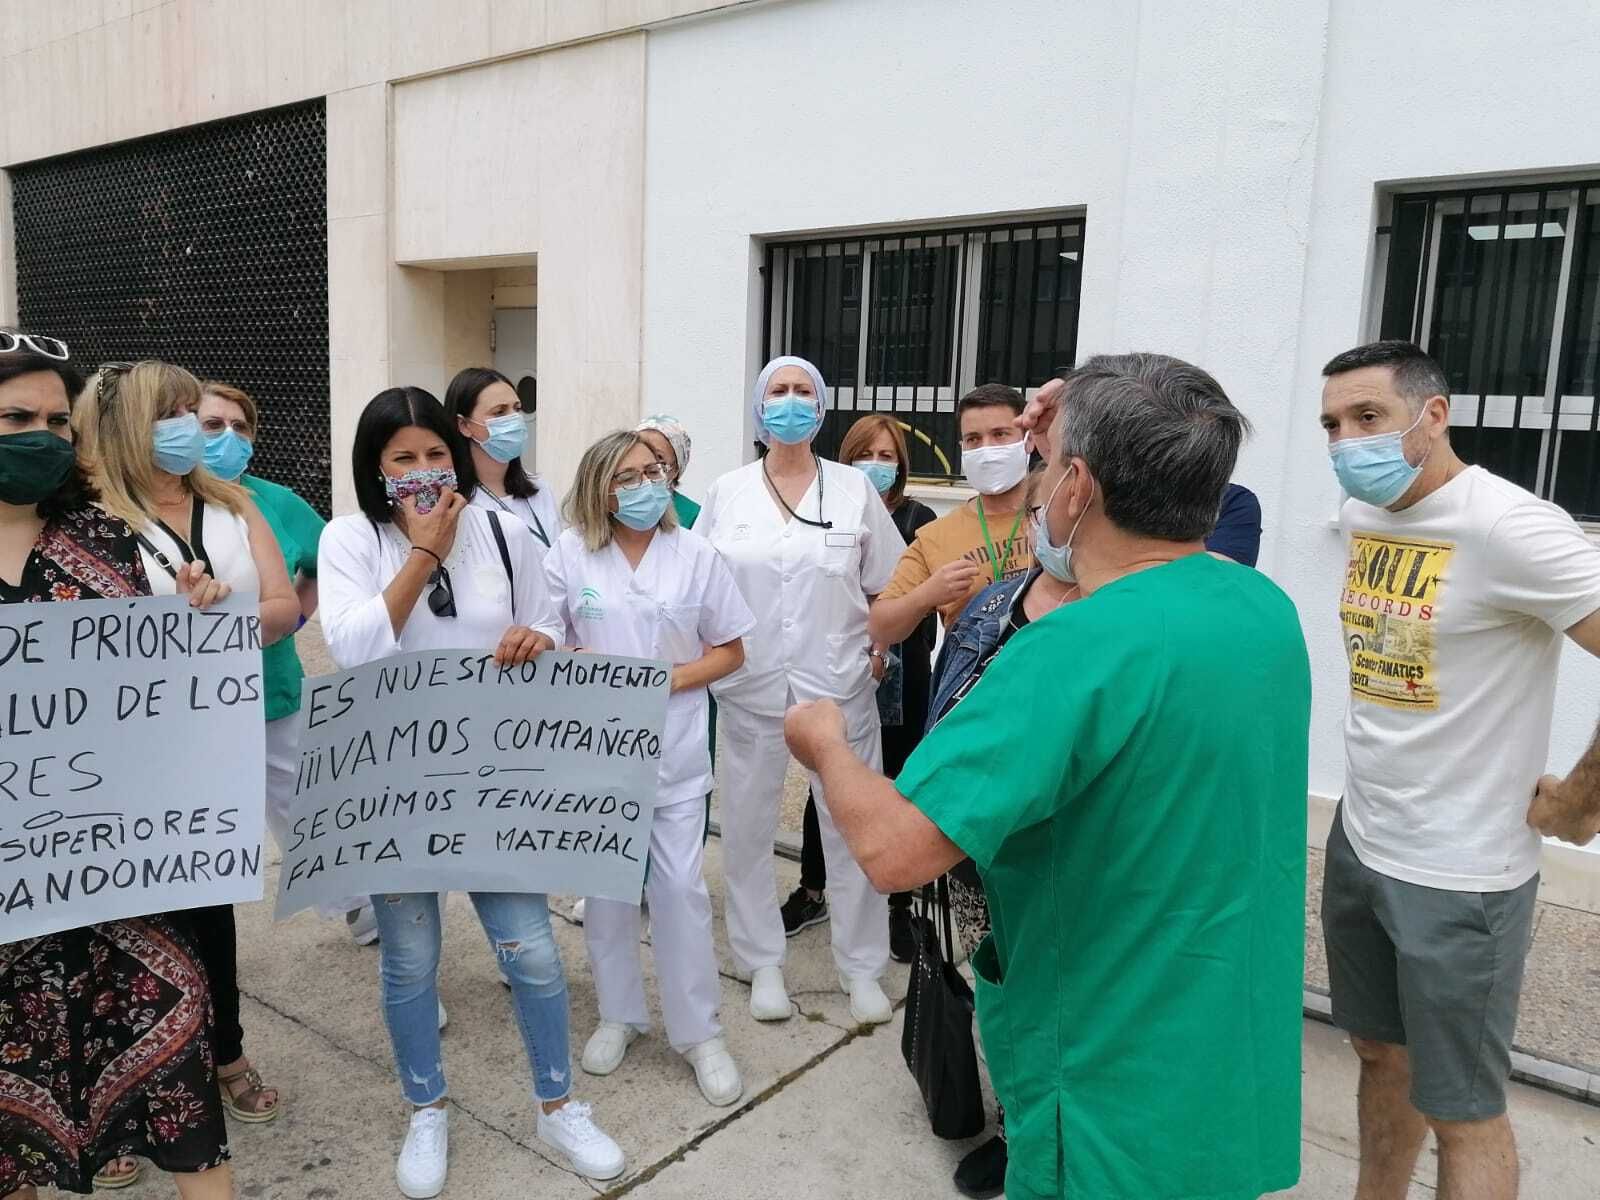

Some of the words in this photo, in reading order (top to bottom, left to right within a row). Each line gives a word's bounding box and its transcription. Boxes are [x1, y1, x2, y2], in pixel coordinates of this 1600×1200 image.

[1352, 543, 1430, 600] SOUL
[0, 620, 44, 667] DE
[71, 602, 262, 661] PRIORIZAR
[309, 677, 355, 729] ES
[376, 655, 537, 700] NUESTRO
[551, 659, 668, 688] MOMENTO
[1378, 660, 1424, 679] FANATICS
[0, 685, 88, 738] LUD
[117, 680, 166, 721] DE
[190, 674, 260, 711] LOS
[0, 808, 239, 862] SUPERIORES
[288, 786, 457, 852] SEGUIMOS
[478, 788, 641, 822] TENIENDO
[0, 844, 261, 915] ANDONARON
[287, 838, 402, 890] FALTA
[428, 833, 467, 857] DE
[497, 825, 639, 862] MATERIAL
